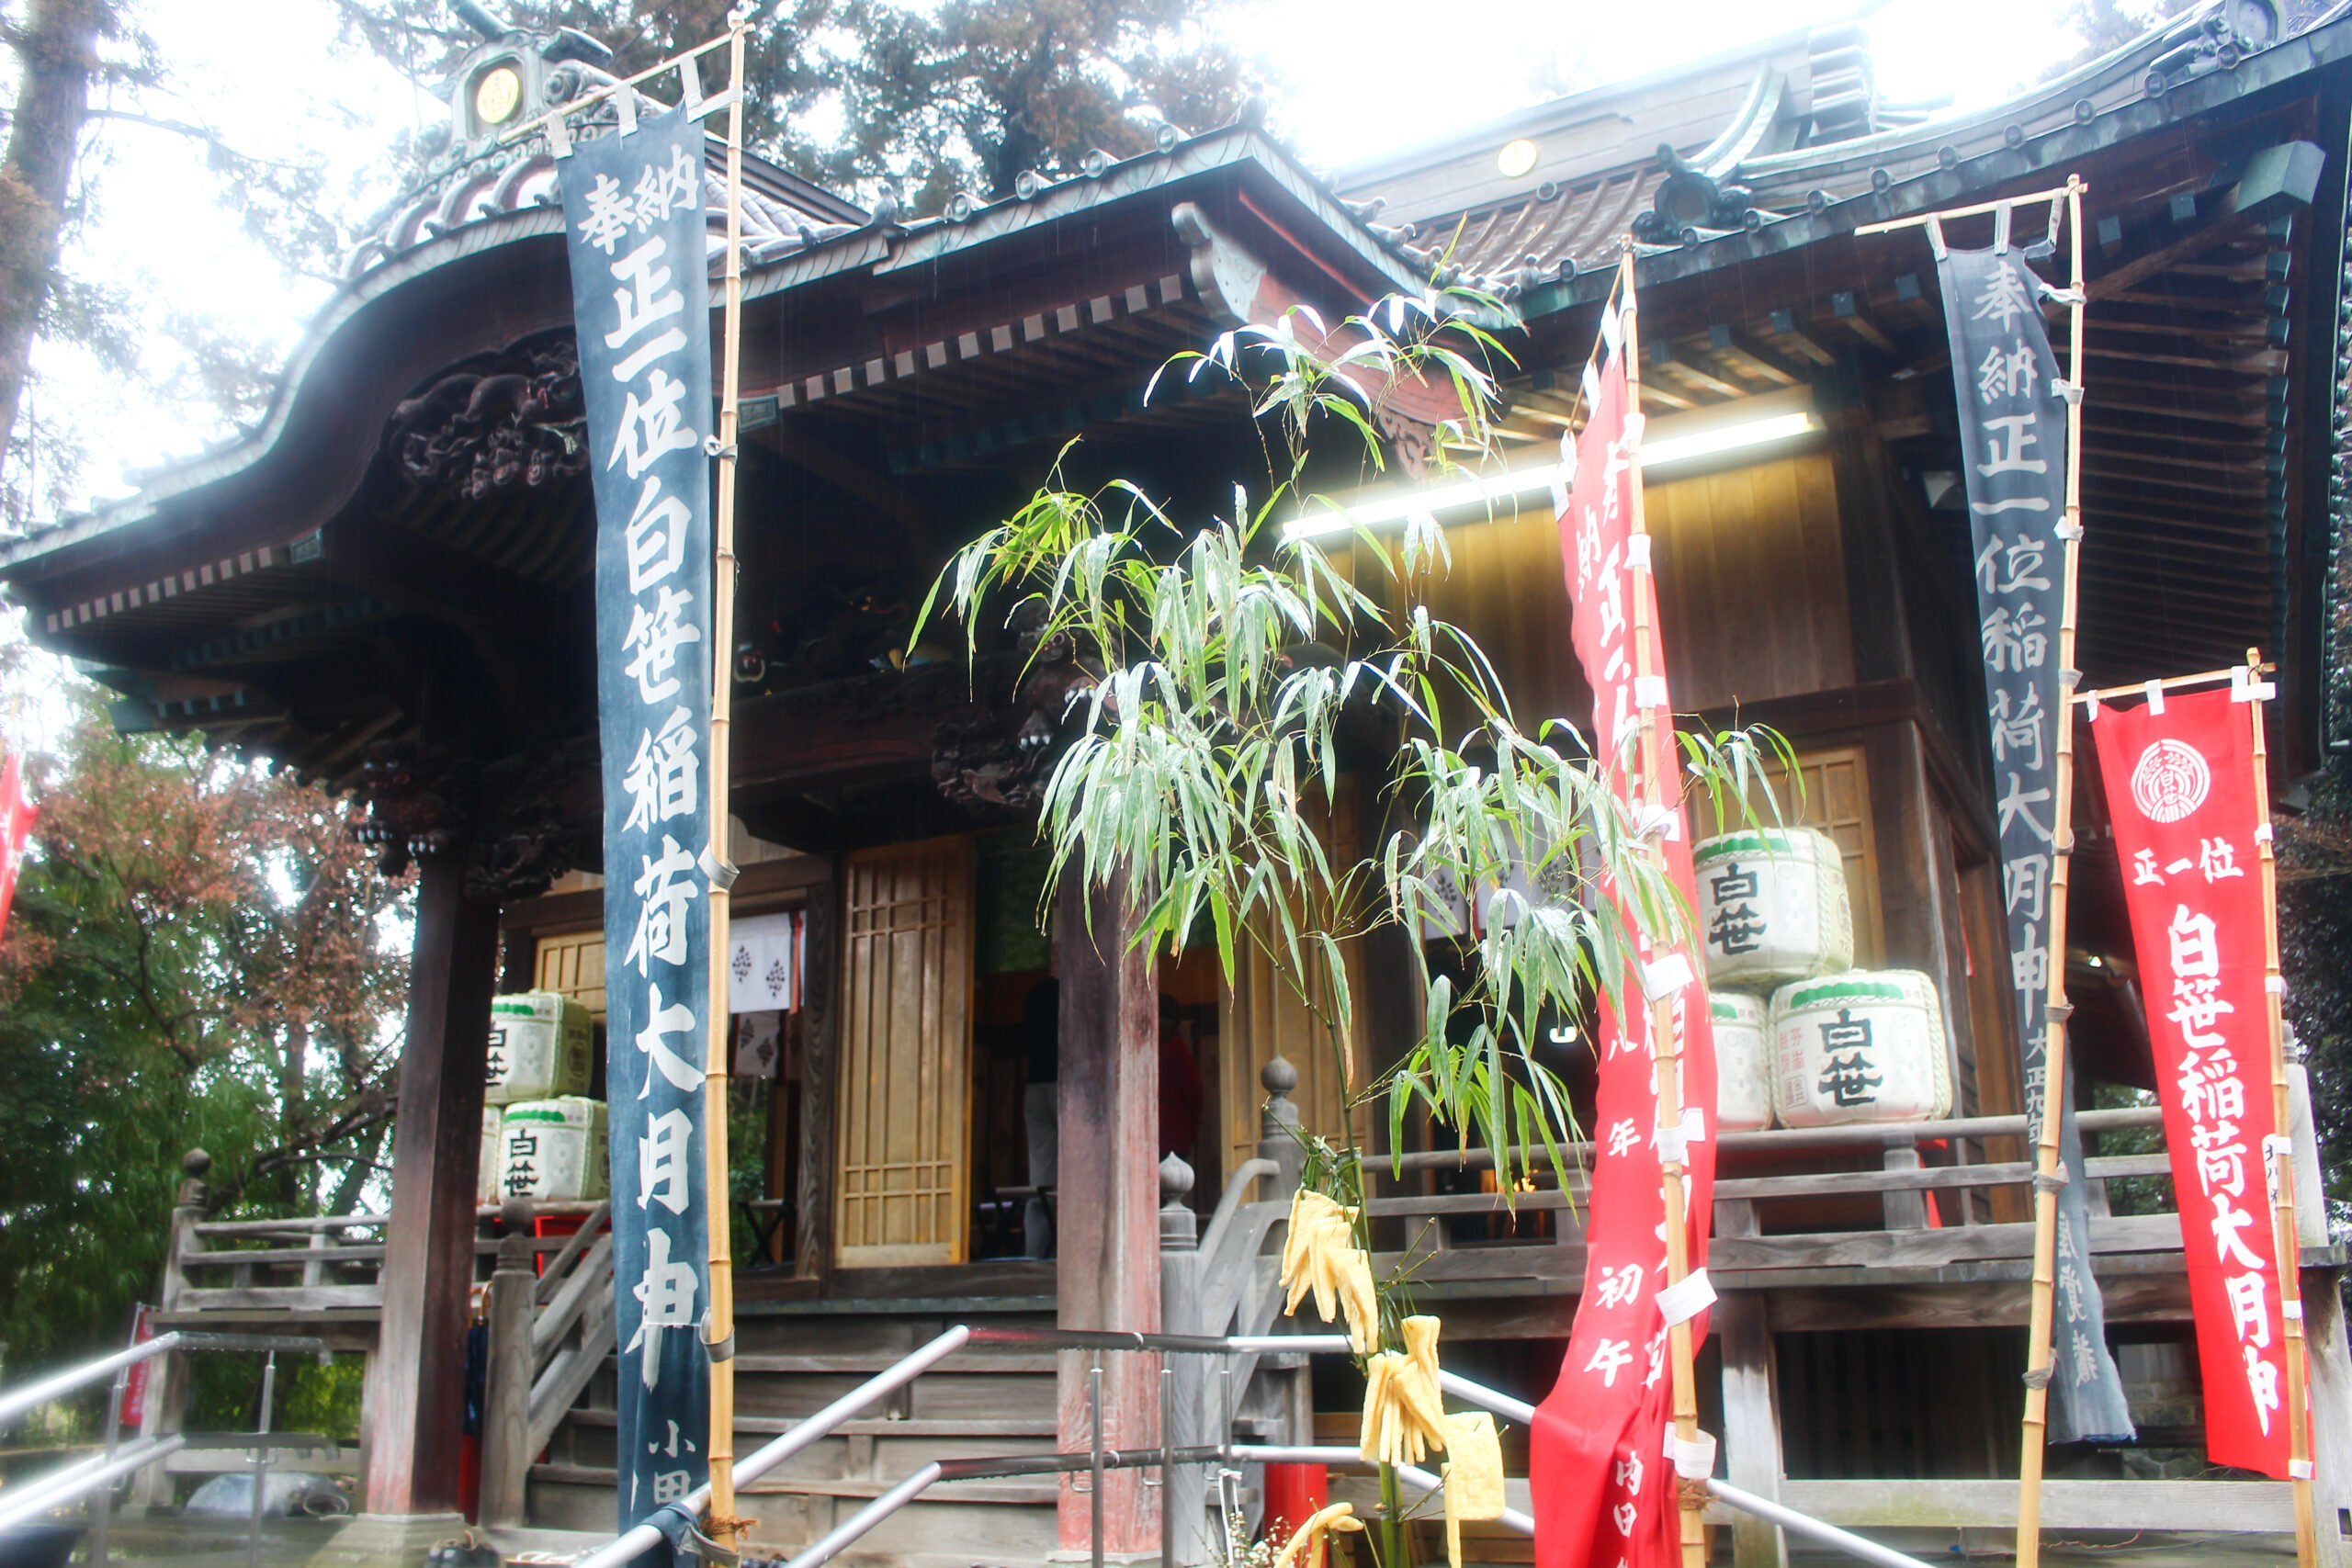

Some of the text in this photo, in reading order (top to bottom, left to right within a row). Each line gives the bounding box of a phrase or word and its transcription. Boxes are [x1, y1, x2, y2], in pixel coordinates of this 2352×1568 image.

[577, 143, 700, 255] 奉納
[2132, 837, 2245, 886] 正一位
[1709, 862, 1767, 955] 白笹
[1818, 1008, 1883, 1108] 白笹
[503, 1128, 539, 1198] 白笹
